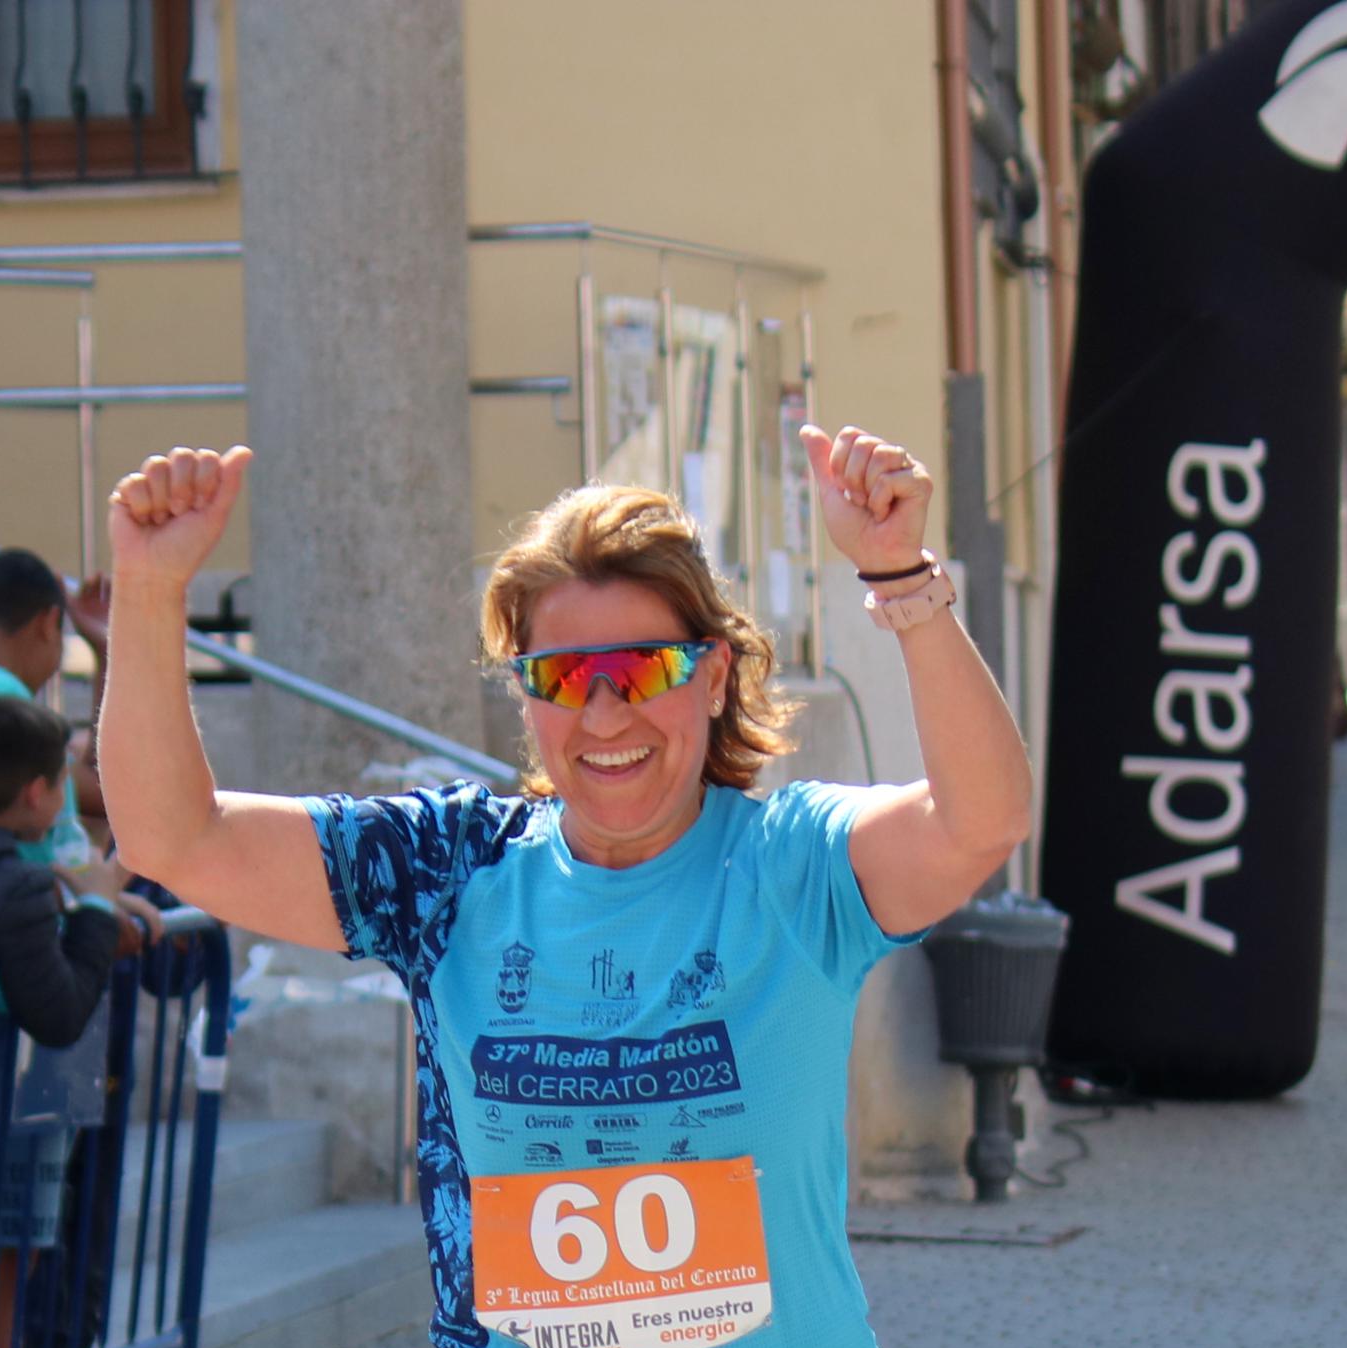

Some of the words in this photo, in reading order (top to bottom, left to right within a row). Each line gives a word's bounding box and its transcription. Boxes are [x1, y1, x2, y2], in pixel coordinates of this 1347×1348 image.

[1115, 438, 1268, 955] Adarsa
[534, 1042, 609, 1069] Media
[619, 1031, 720, 1069] Maratón
[479, 1071, 509, 1096] del
[518, 1073, 658, 1101] CERRATO
[667, 1061, 734, 1094] 2023
[530, 1174, 696, 1282] 60
[508, 1287, 560, 1307] Legua
[566, 1279, 654, 1302] Castellana
[660, 1272, 685, 1291] del
[691, 1266, 757, 1286] Cerrato
[632, 1311, 671, 1330] Eres
[679, 1299, 753, 1325] nuestra
[660, 1319, 736, 1344] energía
